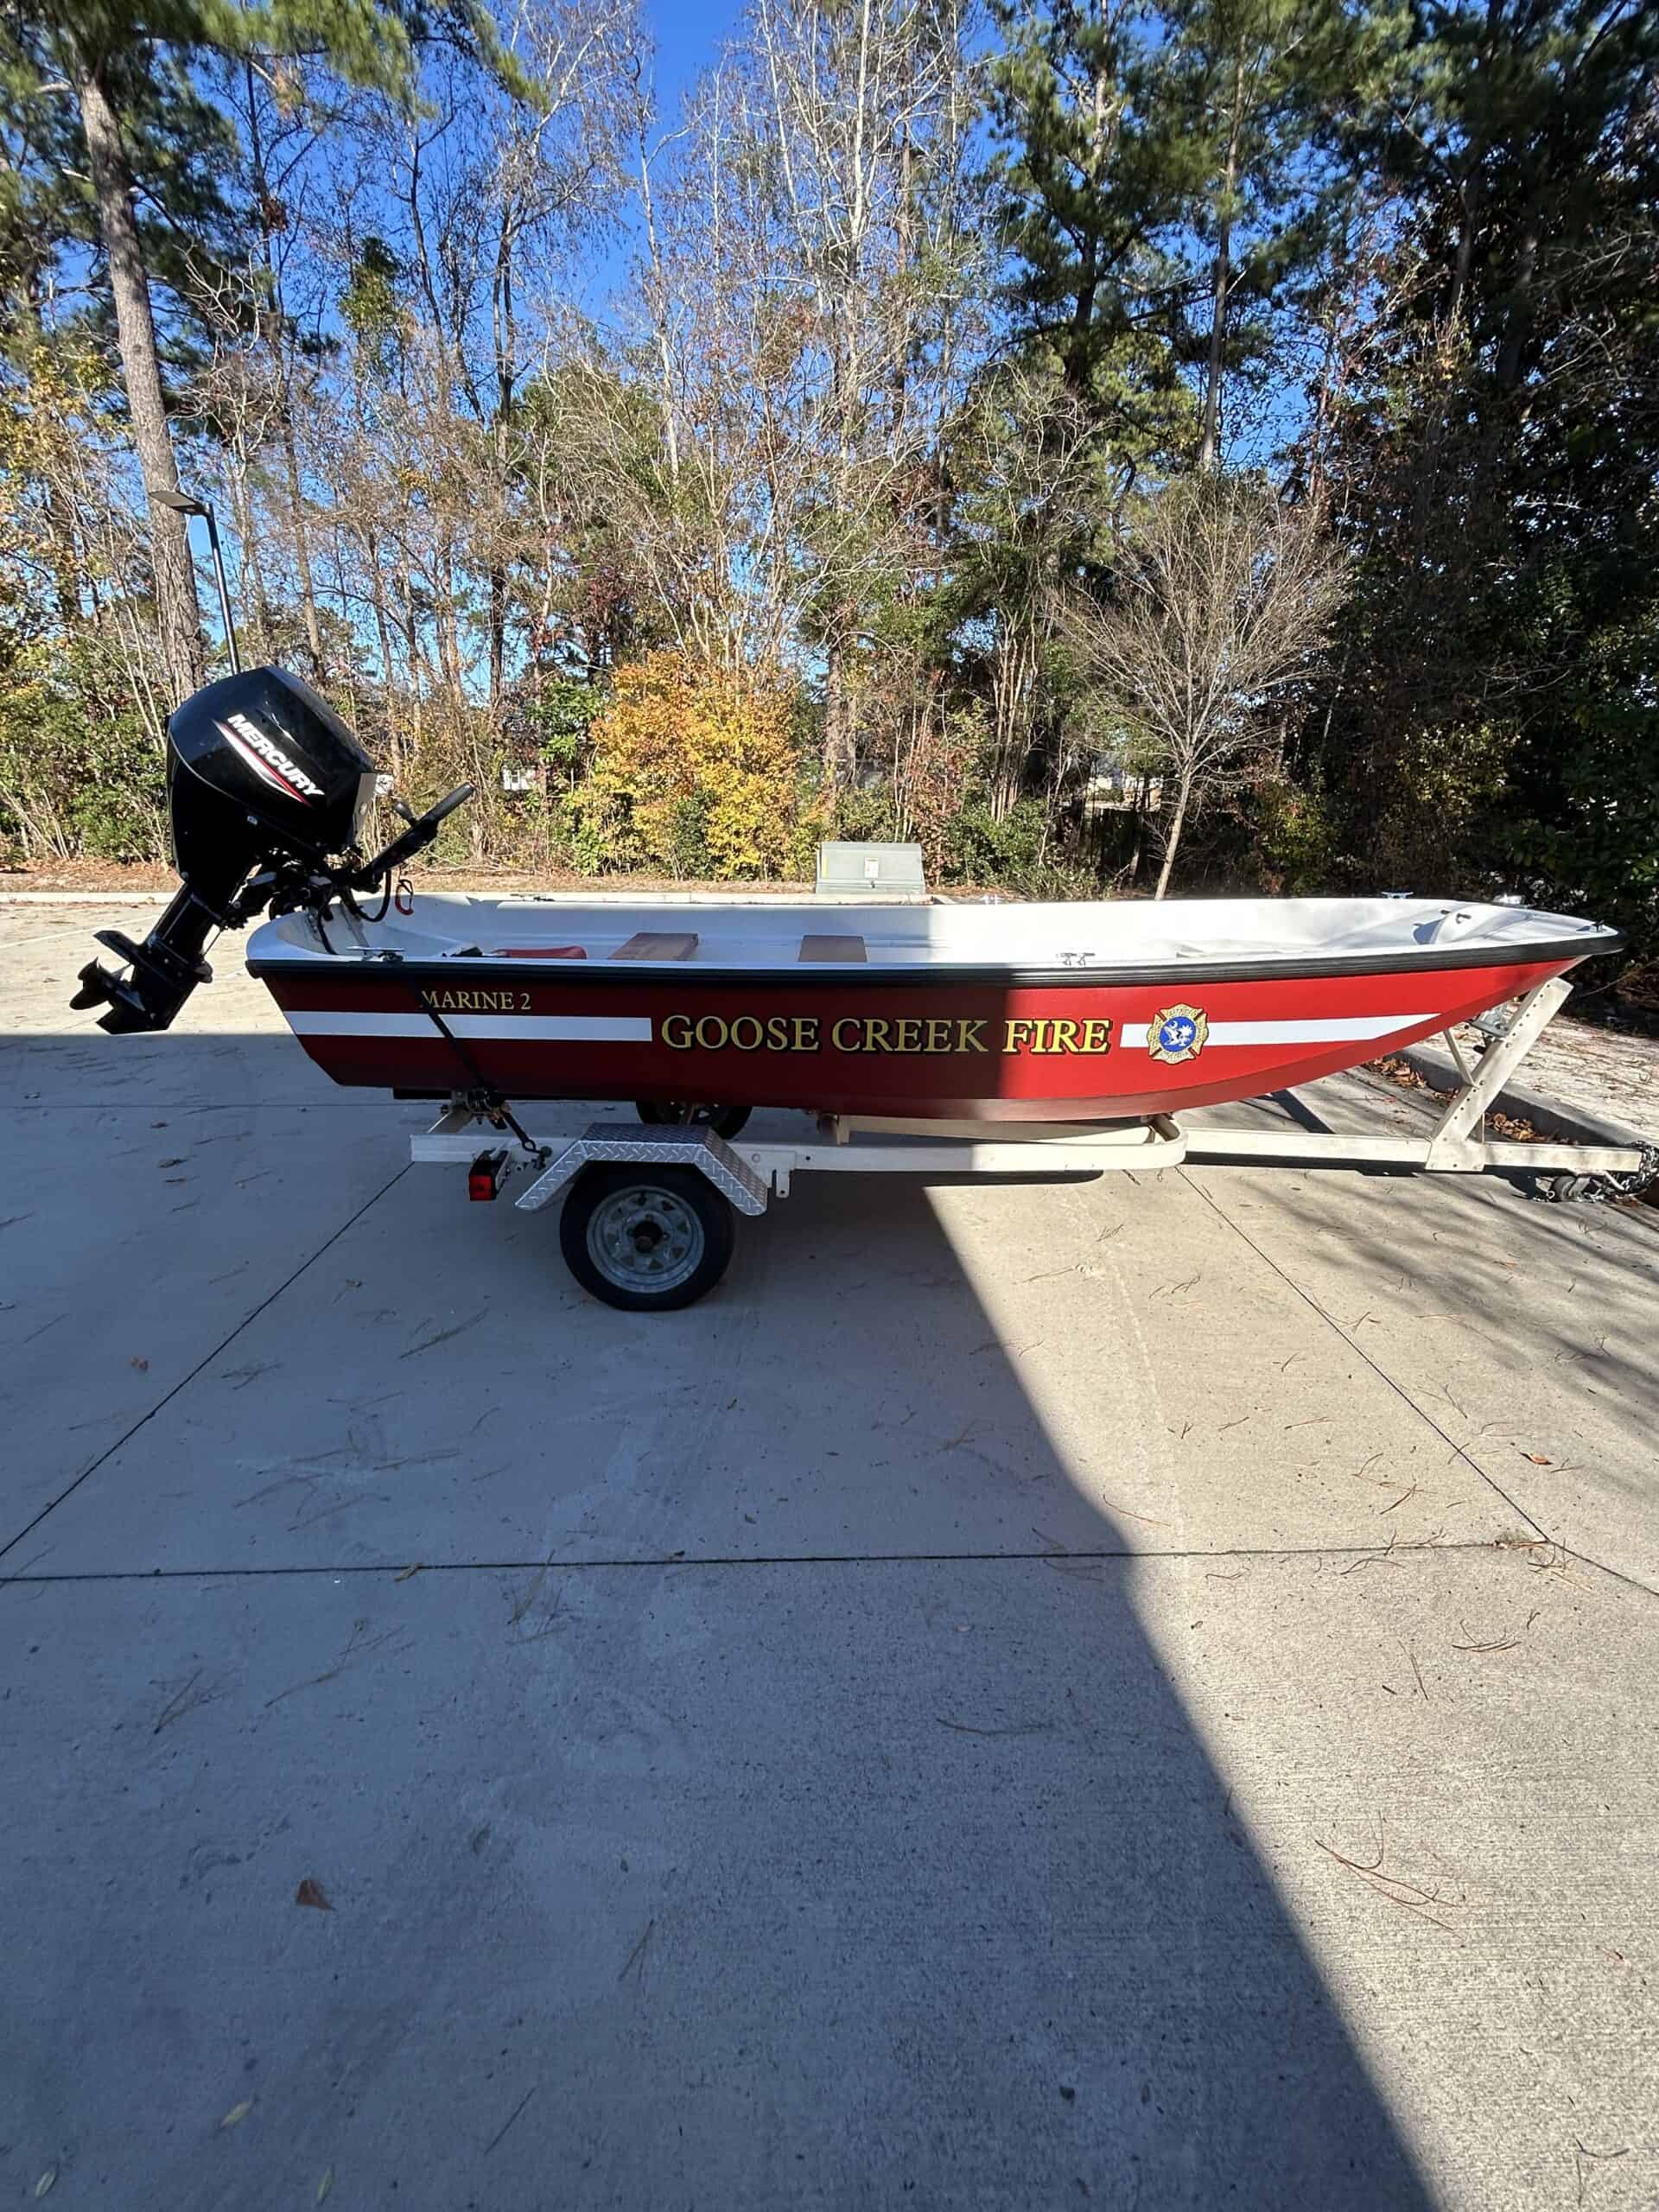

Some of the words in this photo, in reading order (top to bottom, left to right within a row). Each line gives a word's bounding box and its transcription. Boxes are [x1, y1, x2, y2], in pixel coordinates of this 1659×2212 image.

[227, 714, 325, 796] MERCURY
[419, 989, 515, 1009] MARINE
[520, 992, 532, 1010] 2
[661, 1014, 820, 1051] GOOSE
[831, 1018, 989, 1052] CREEK
[1001, 1020, 1109, 1052] FIRE
